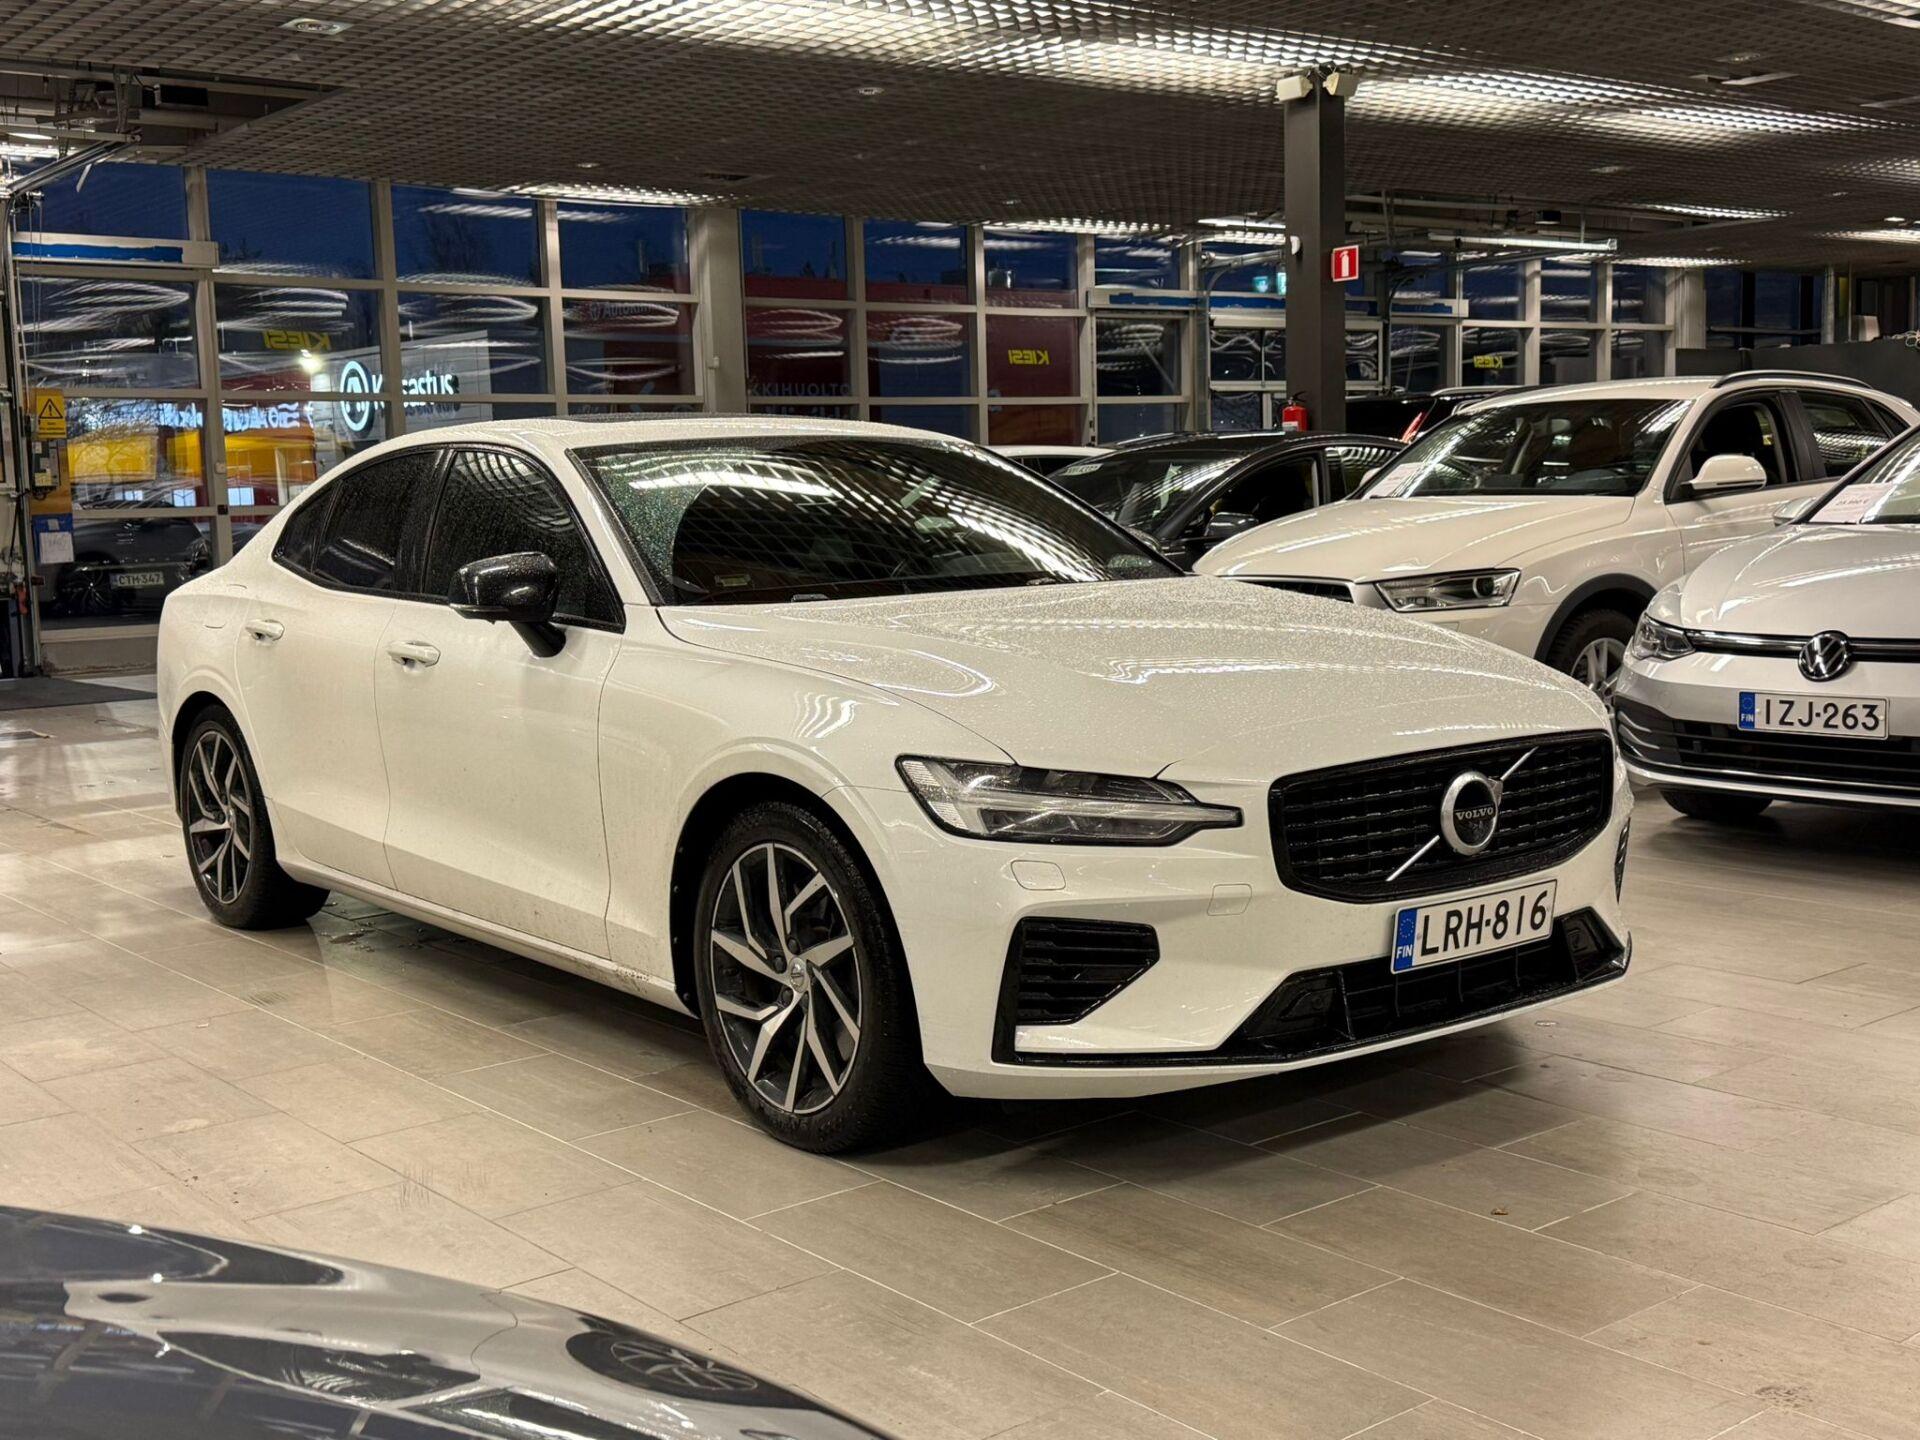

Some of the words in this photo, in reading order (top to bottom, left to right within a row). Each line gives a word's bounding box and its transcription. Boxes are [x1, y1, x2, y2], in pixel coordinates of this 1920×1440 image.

[1741, 713, 1754, 722] FIN
[1765, 699, 1879, 731] IZJ-263
[1455, 806, 1494, 821] VOLVO
[1396, 944, 1413, 959] FIN
[1421, 891, 1548, 956] LRH-816
